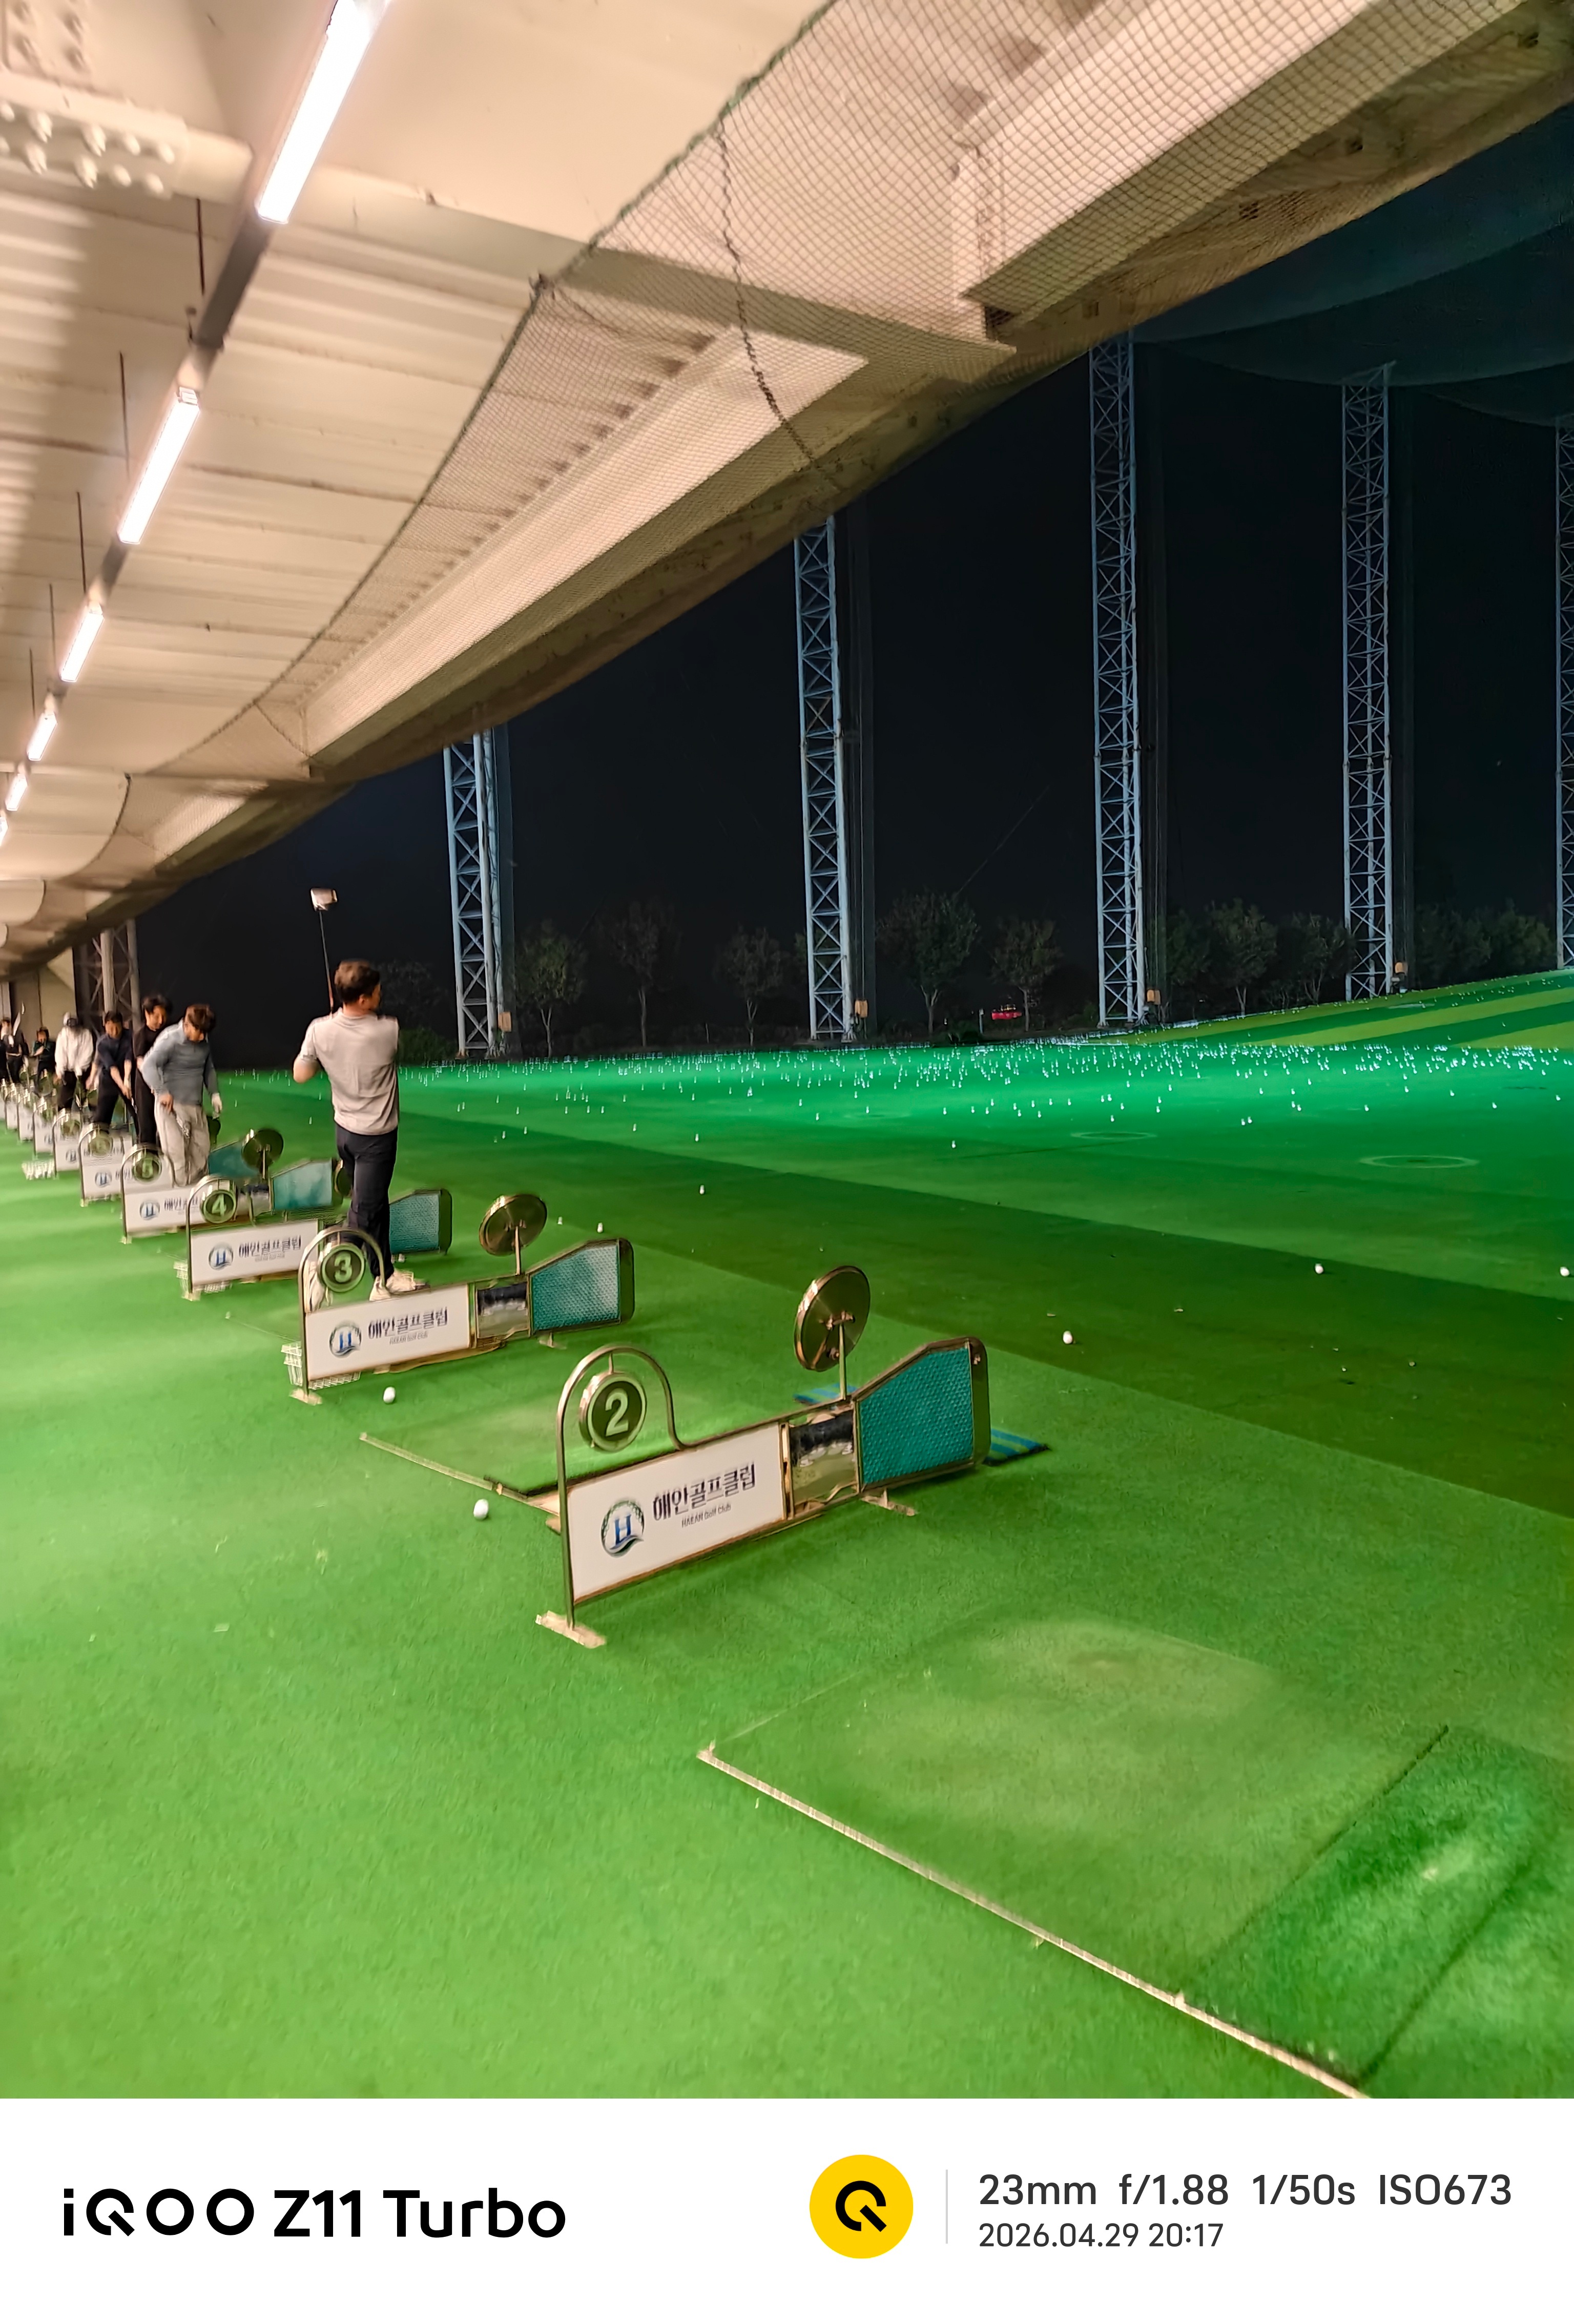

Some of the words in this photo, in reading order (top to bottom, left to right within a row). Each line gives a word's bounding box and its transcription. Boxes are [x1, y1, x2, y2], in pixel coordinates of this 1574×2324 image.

[212, 1194, 227, 1217] 4
[334, 1251, 353, 1282] 3
[605, 1387, 629, 1437] 2
[653, 1463, 755, 1521] 해안골프클럽
